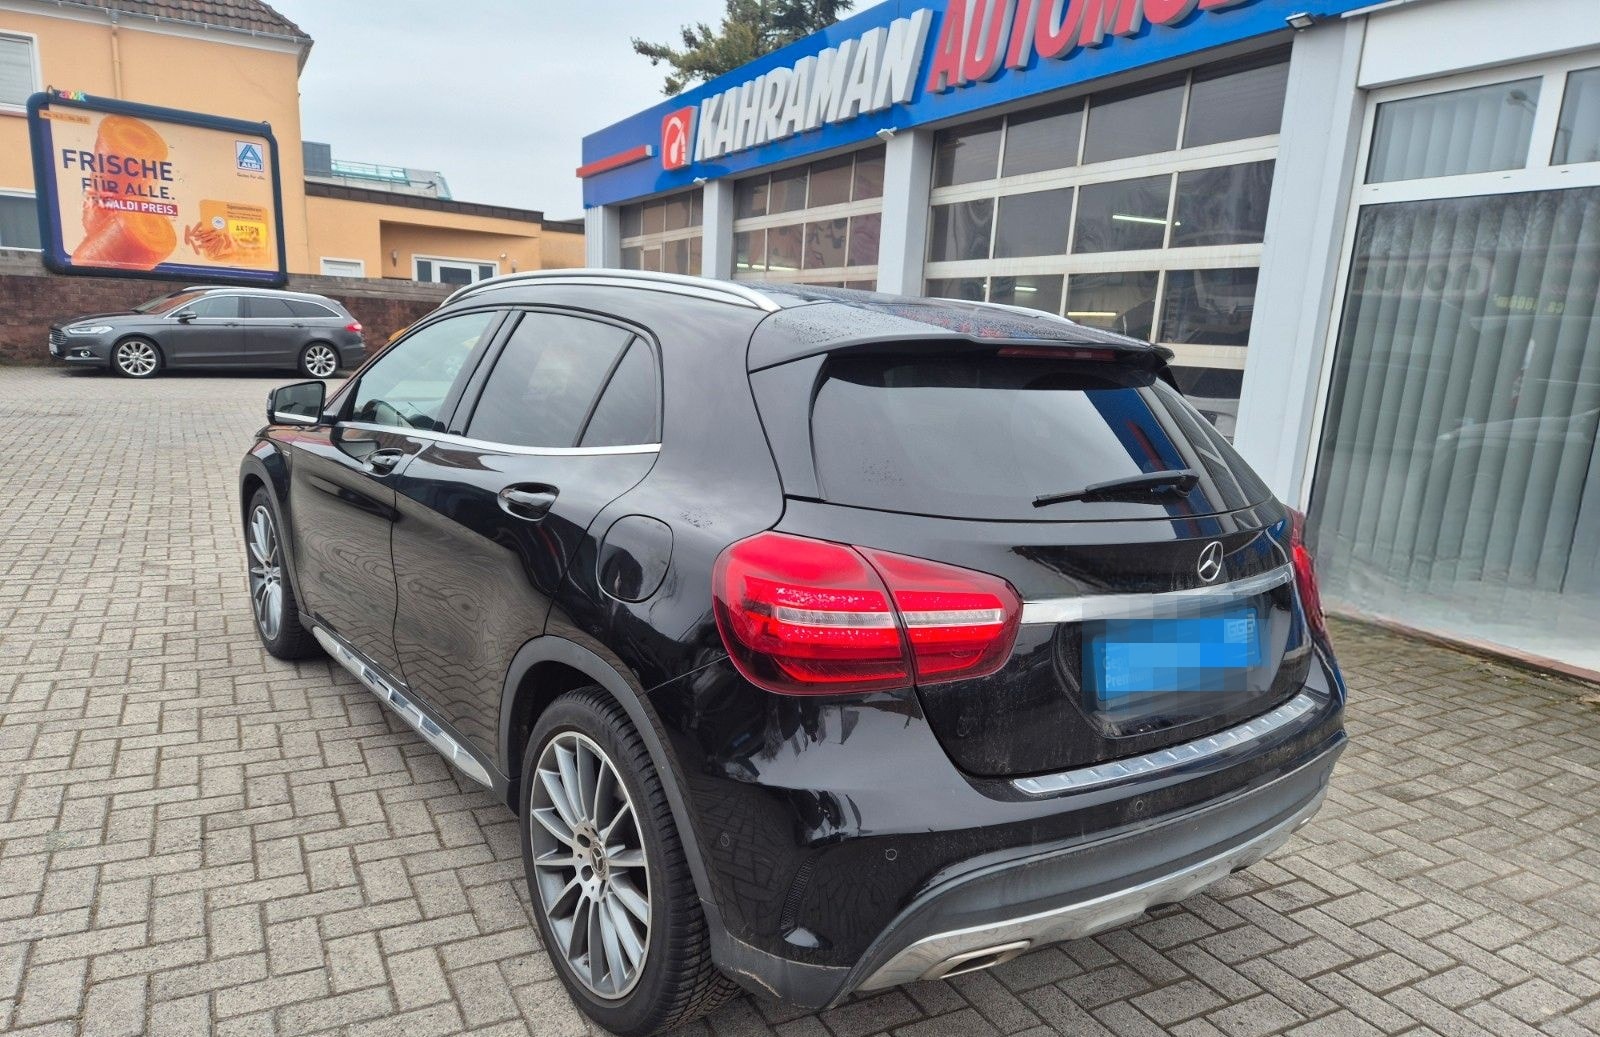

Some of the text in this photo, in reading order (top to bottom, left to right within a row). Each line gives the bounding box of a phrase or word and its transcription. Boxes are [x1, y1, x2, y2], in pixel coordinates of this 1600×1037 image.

[694, 8, 933, 161] KAHRAMAN
[62, 148, 174, 182] FRISCHE
[81, 175, 176, 201] FÜR ALLE.
[141, 203, 177, 215] PREIS.
